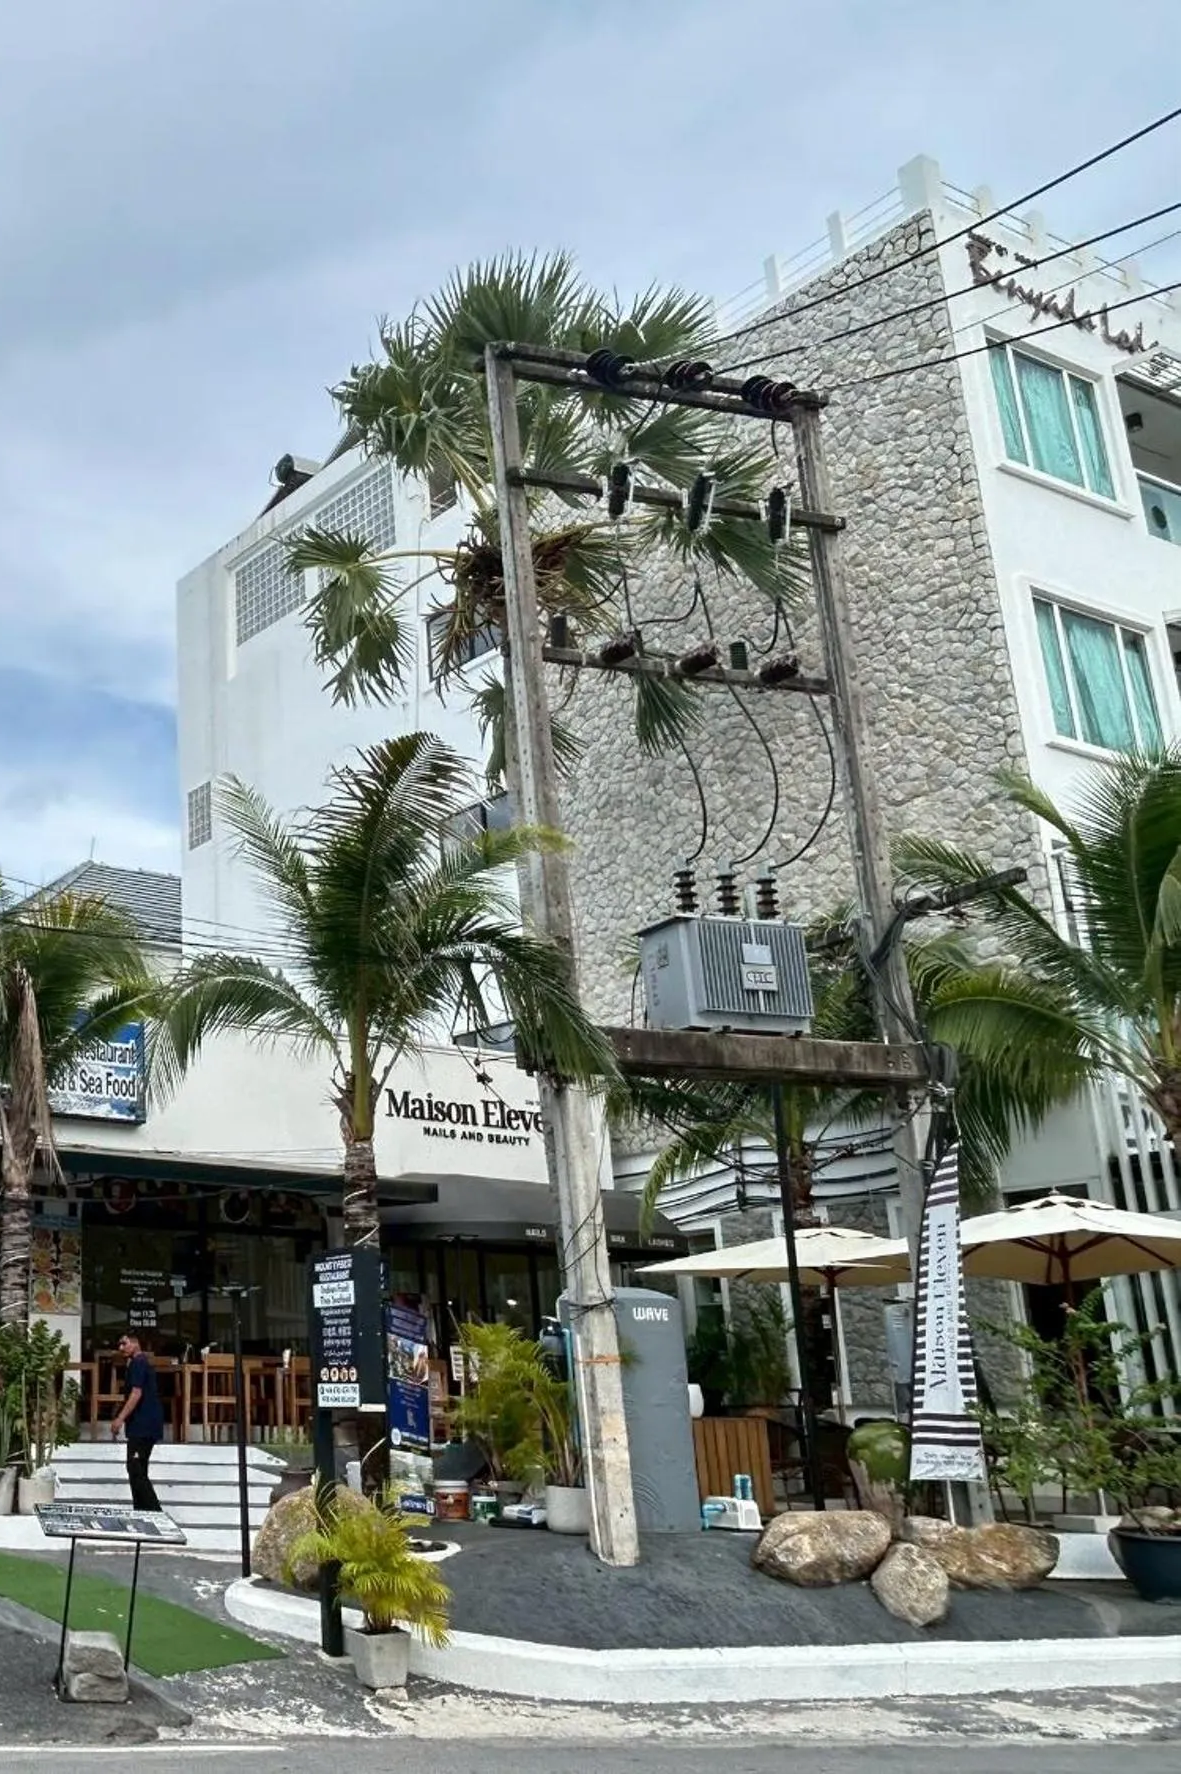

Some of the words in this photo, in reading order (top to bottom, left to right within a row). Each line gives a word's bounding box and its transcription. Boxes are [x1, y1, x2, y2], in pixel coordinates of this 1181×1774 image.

[79, 1069, 103, 1094] Sea
[106, 1072, 136, 1098] Food
[385, 1088, 478, 1127] Maison
[480, 1099, 544, 1133] Eleve
[423, 1126, 457, 1140] NAILS
[460, 1131, 484, 1142] AND
[487, 1133, 530, 1147] BEAUTY
[633, 1307, 669, 1322] WAVE
[929, 1307, 948, 1391] Maison
